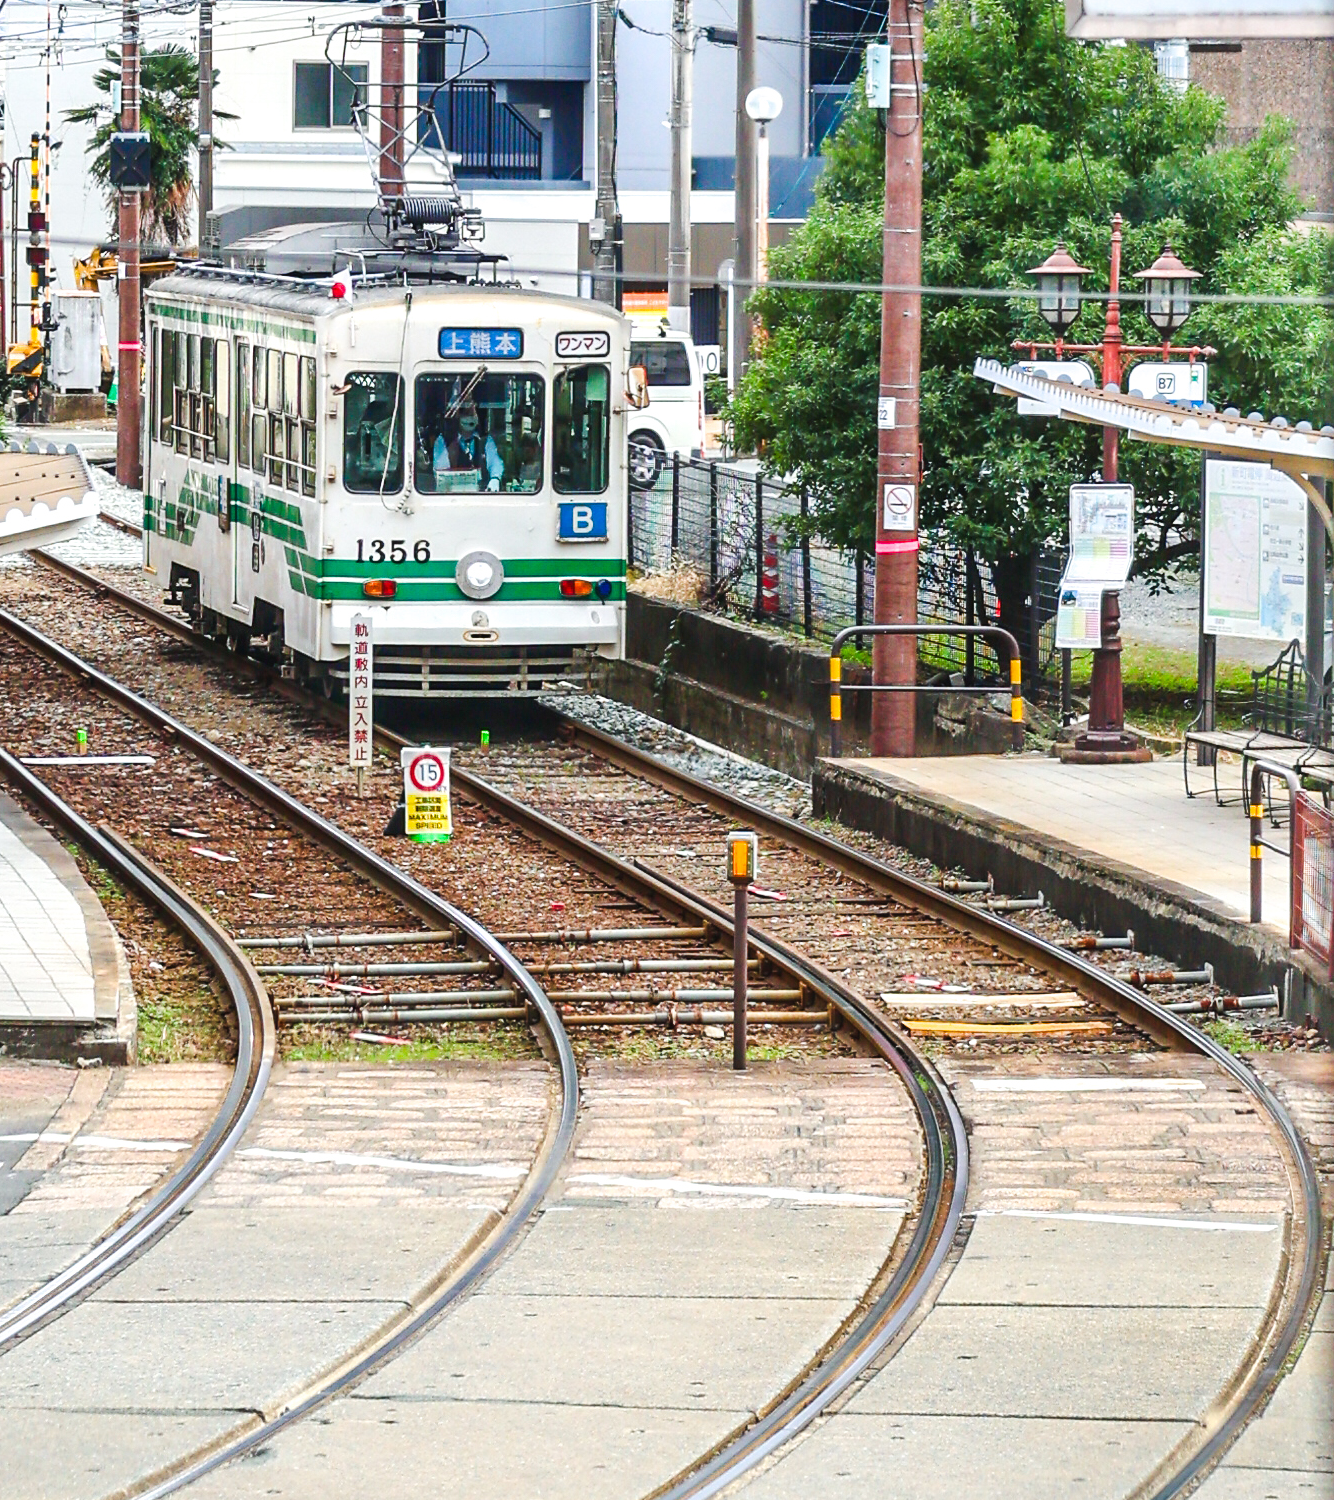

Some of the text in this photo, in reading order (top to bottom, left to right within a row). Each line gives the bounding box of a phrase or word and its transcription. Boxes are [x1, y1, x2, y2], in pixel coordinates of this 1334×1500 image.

[444, 331, 518, 355] 上熊本
[558, 337, 608, 353] ワンマン
[572, 506, 594, 534] B
[355, 538, 432, 564] 1356
[354, 623, 369, 762] 軌道敷内立入禁止
[420, 764, 438, 781] 15
